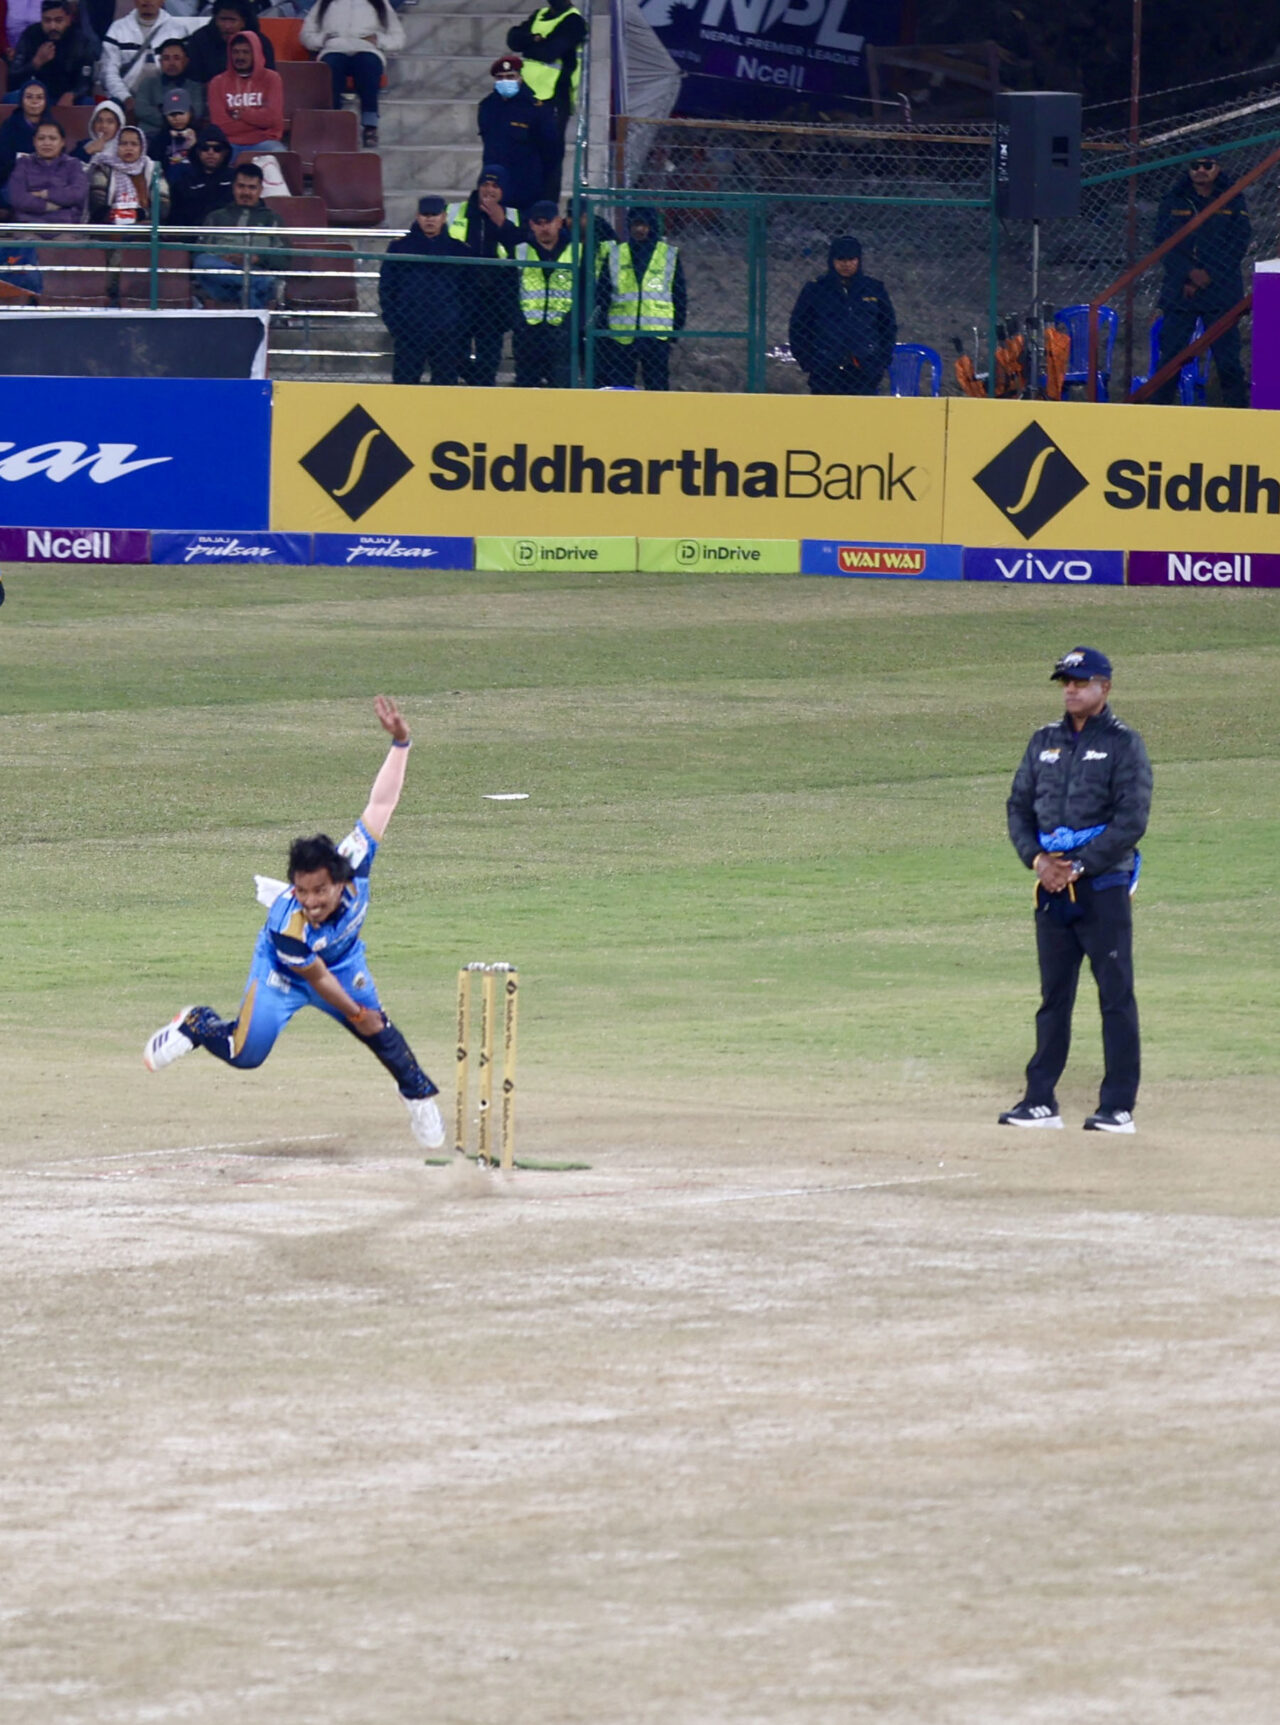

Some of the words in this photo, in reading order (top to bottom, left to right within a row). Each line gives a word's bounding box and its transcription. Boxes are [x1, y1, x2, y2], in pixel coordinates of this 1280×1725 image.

[699, 28, 744, 48] NEPAL
[746, 36, 806, 57] PREMIER
[807, 48, 862, 67] LEAGUE
[735, 54, 806, 88] Ncell
[27, 530, 111, 561] Ncell
[184, 538, 276, 562] pulsar
[198, 536, 231, 544] BAJAJ
[346, 538, 438, 563] pulsar
[360, 537, 392, 545] BAJAJ
[540, 545, 599, 561] inDrive
[702, 545, 761, 561] inDrive
[841, 551, 880, 568] WAI
[882, 552, 921, 570] WAI
[995, 552, 1093, 581] vivo
[1167, 553, 1252, 583] Ncell
